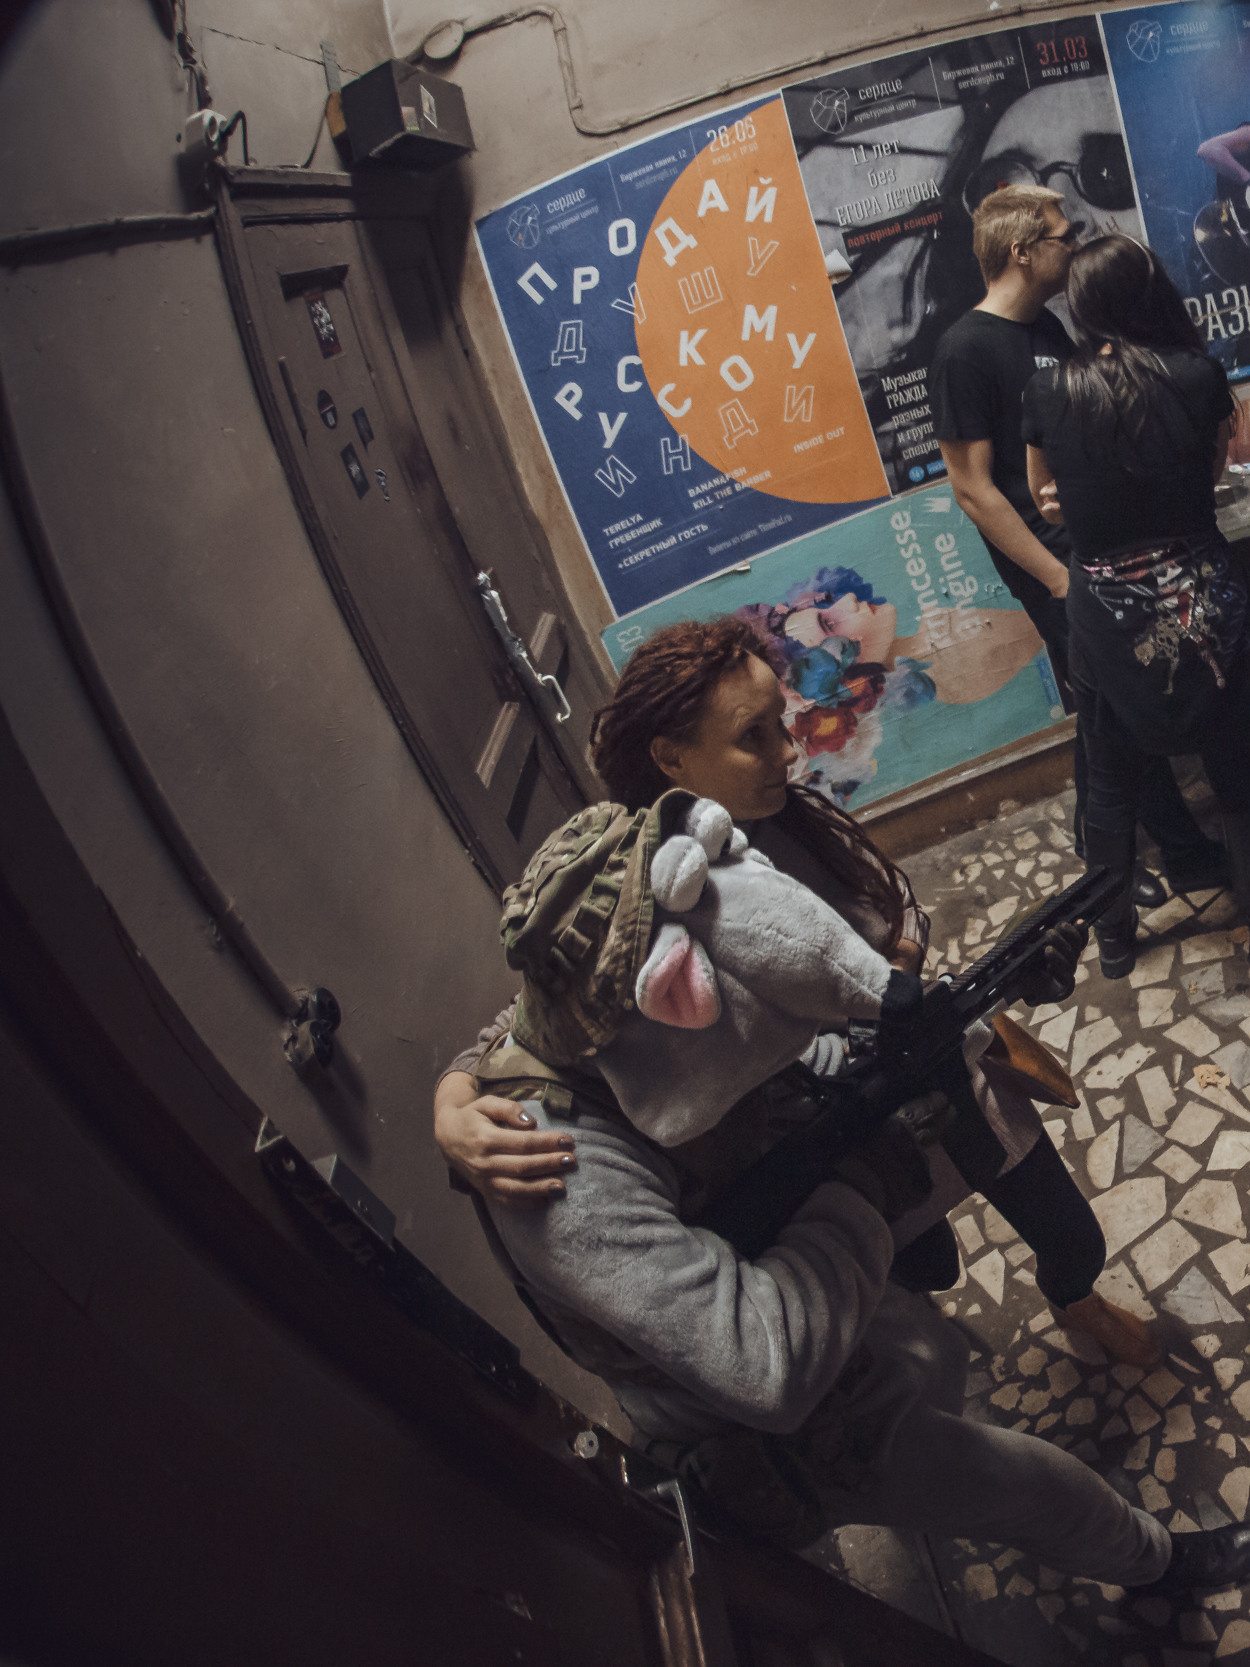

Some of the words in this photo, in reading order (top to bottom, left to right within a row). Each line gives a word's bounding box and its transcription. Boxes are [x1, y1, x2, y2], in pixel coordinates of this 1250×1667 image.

[1036, 35, 1088, 65] 31.03
[942, 64, 979, 82] Биржевая
[1007, 56, 1017, 66] 12
[857, 77, 904, 101] сердце
[854, 101, 896, 123] культурный
[896, 98, 917, 116] центр
[706, 115, 757, 153] 26.06
[850, 145, 868, 166] 11
[872, 138, 901, 161] лет
[867, 168, 897, 190] без
[546, 187, 587, 214] сердце
[835, 191, 883, 227] ЕГОРА
[884, 178, 942, 214] ЛЕТОВА
[847, 220, 902, 249] повторный
[903, 210, 943, 231] концерт
[886, 383, 929, 409] ГРАЖДА
[892, 404, 932, 429] разных
[794, 434, 825, 454] INSIDE
[826, 426, 846, 441] OUT
[897, 432, 906, 443] и
[902, 439, 940, 461] специа
[692, 494, 713, 511] KILL
[715, 487, 732, 501] THE
[734, 470, 773, 491] BARBER
[603, 513, 644, 537] TERELYA
[608, 518, 664, 549] ГРЕБЕНЩИК
[618, 534, 678, 569] +СЕКРЕТНЫЙ
[678, 523, 709, 546] ГОСТЬ
